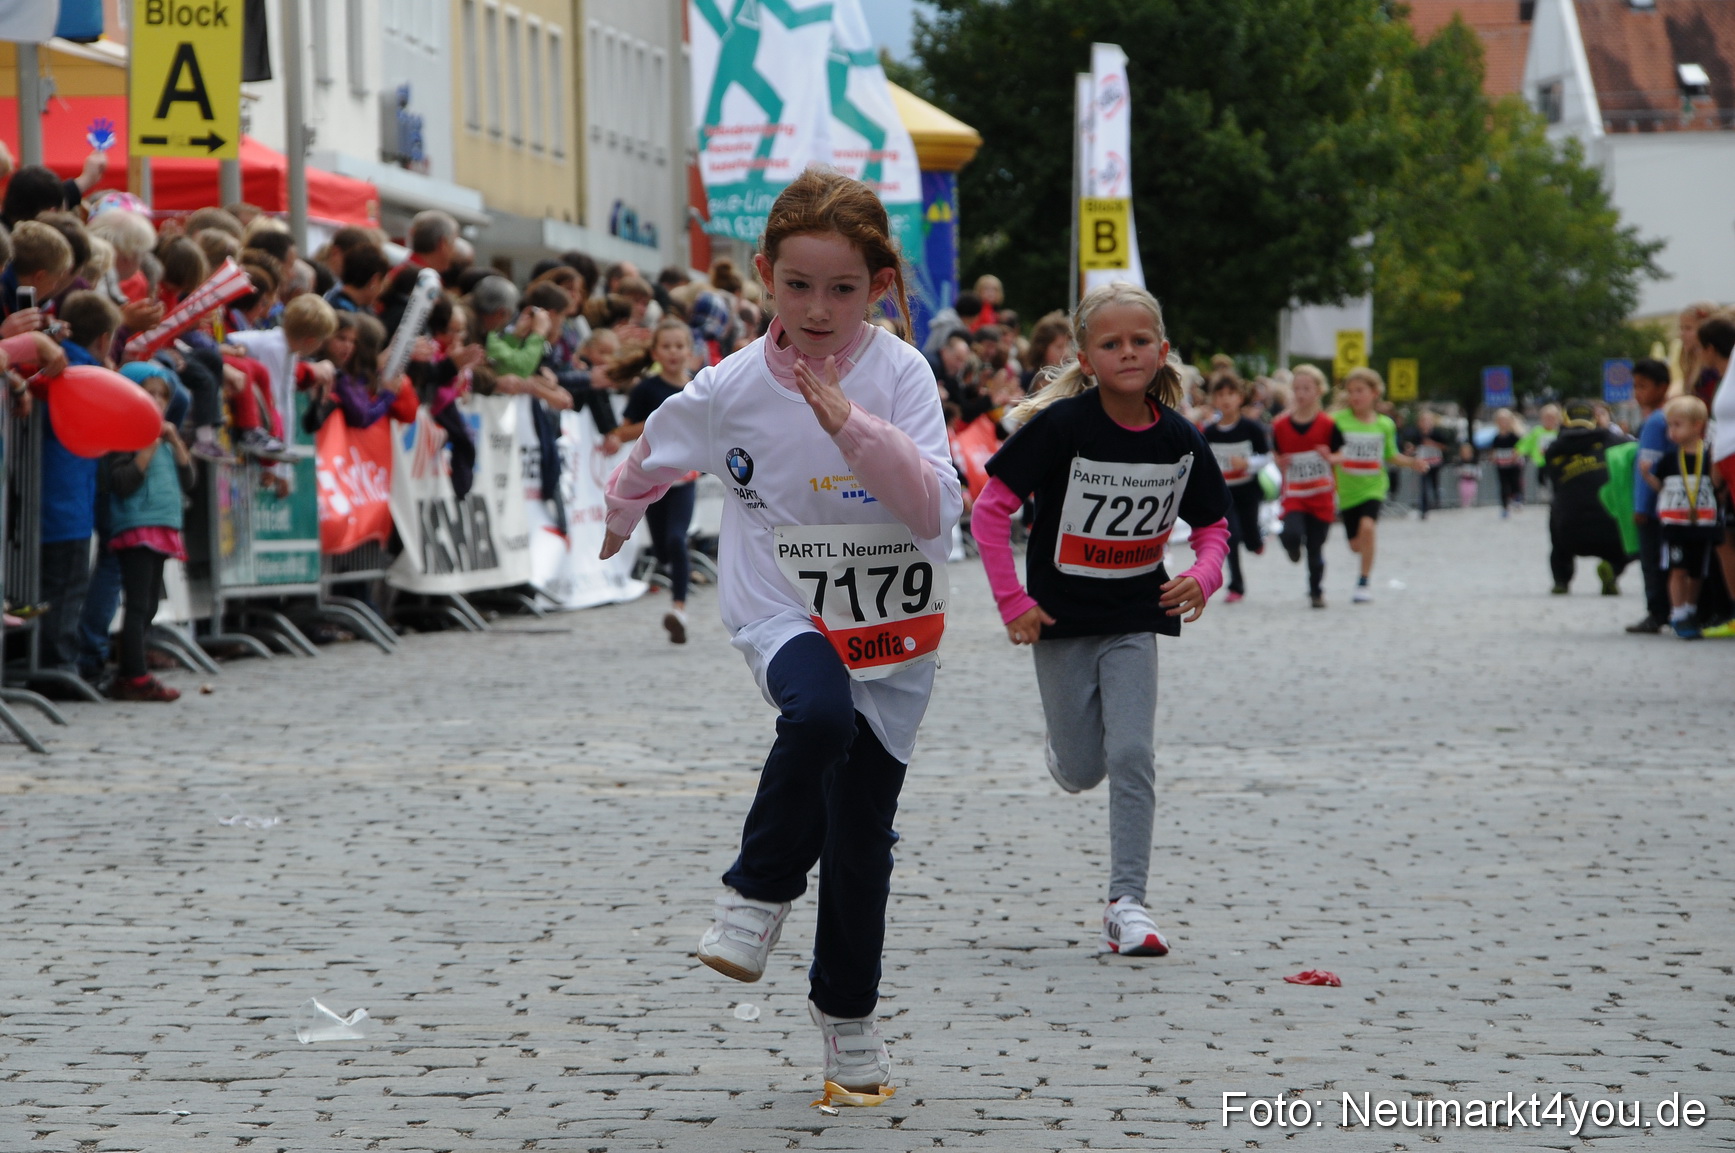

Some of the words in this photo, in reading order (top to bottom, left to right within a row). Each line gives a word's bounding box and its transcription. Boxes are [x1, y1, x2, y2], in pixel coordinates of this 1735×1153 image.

[145, 0, 228, 27] Block
[153, 42, 215, 120] A
[1094, 220, 1117, 254] B
[1341, 341, 1360, 366] C
[809, 476, 838, 493] 14.
[1073, 469, 1118, 487] PARTL
[1122, 475, 1176, 488] Neumark
[1082, 491, 1175, 537] 7222
[778, 543, 838, 558] PARTL
[842, 541, 919, 557] Neumark
[1083, 543, 1161, 565] Valentina
[798, 561, 934, 623] 7179
[847, 632, 905, 662] Sofia
